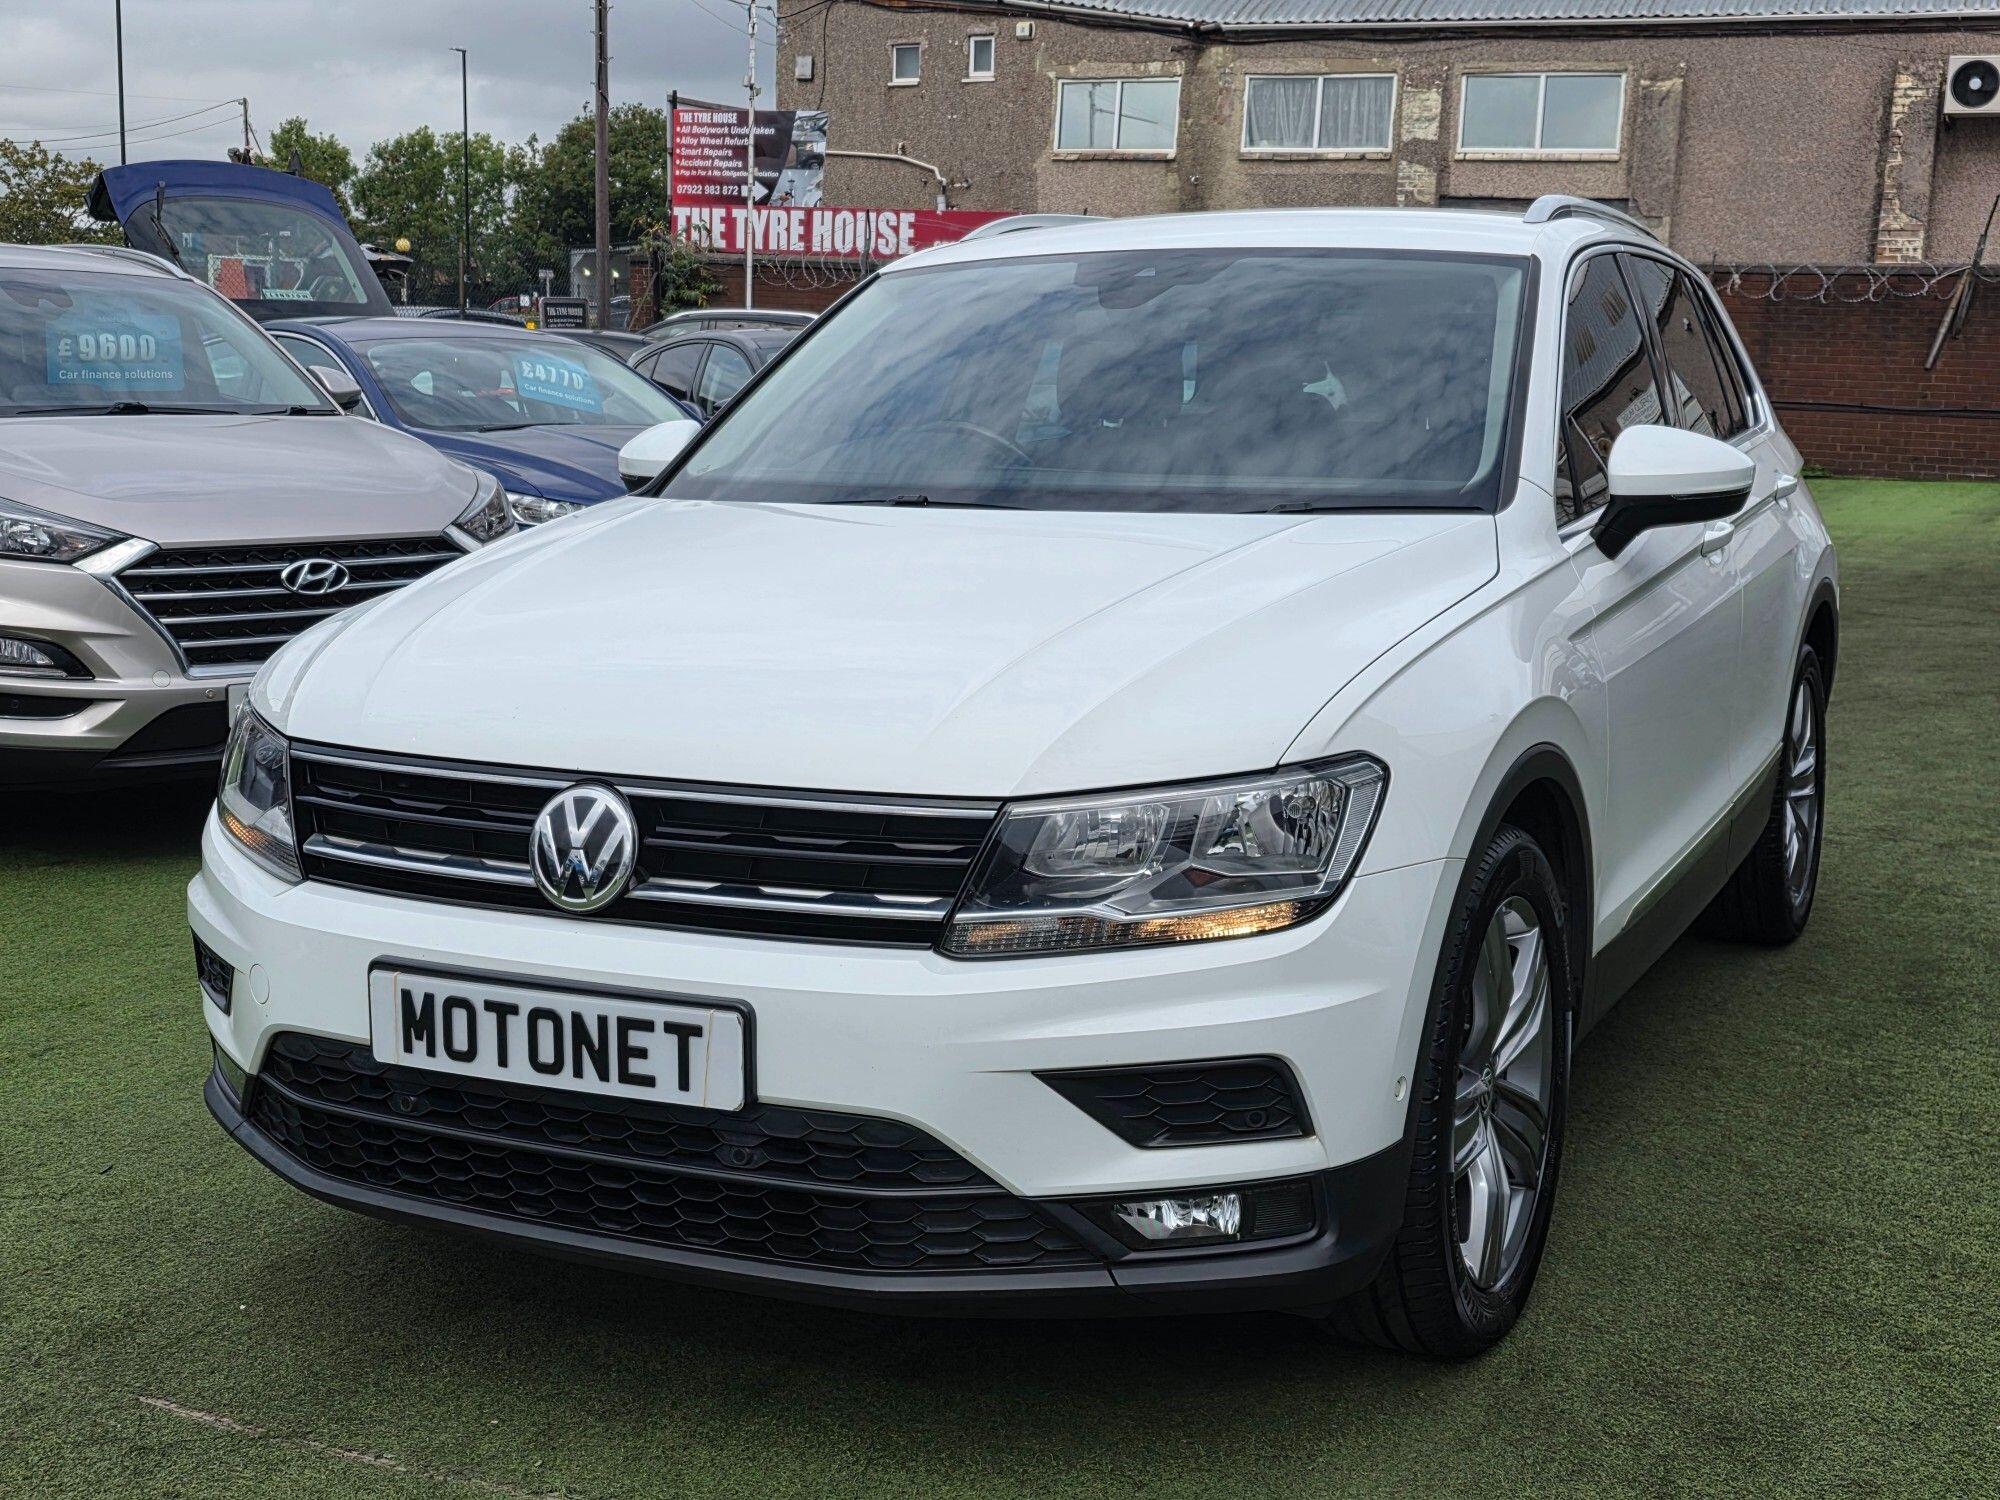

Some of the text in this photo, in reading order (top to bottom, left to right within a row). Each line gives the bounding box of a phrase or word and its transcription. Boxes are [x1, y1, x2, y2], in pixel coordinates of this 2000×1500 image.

[679, 112, 737, 123] THE TYRE HOUSE
[681, 126, 775, 136] All Bodywork Undetaken
[680, 137, 699, 146] Alloy
[700, 137, 723, 145] Wheel
[680, 147, 733, 157] Smart Repairs
[680, 158, 743, 168] Accident Repairs
[676, 185, 739, 195] 07922 983 872
[673, 207, 916, 255] THE TYRE HOUSE
[58, 333, 156, 361] £9600
[59, 369, 173, 379] Car finance solutions
[521, 361, 584, 390] £4770
[524, 383, 595, 405] Car finance solutions
[399, 987, 704, 1093] MOTONET
